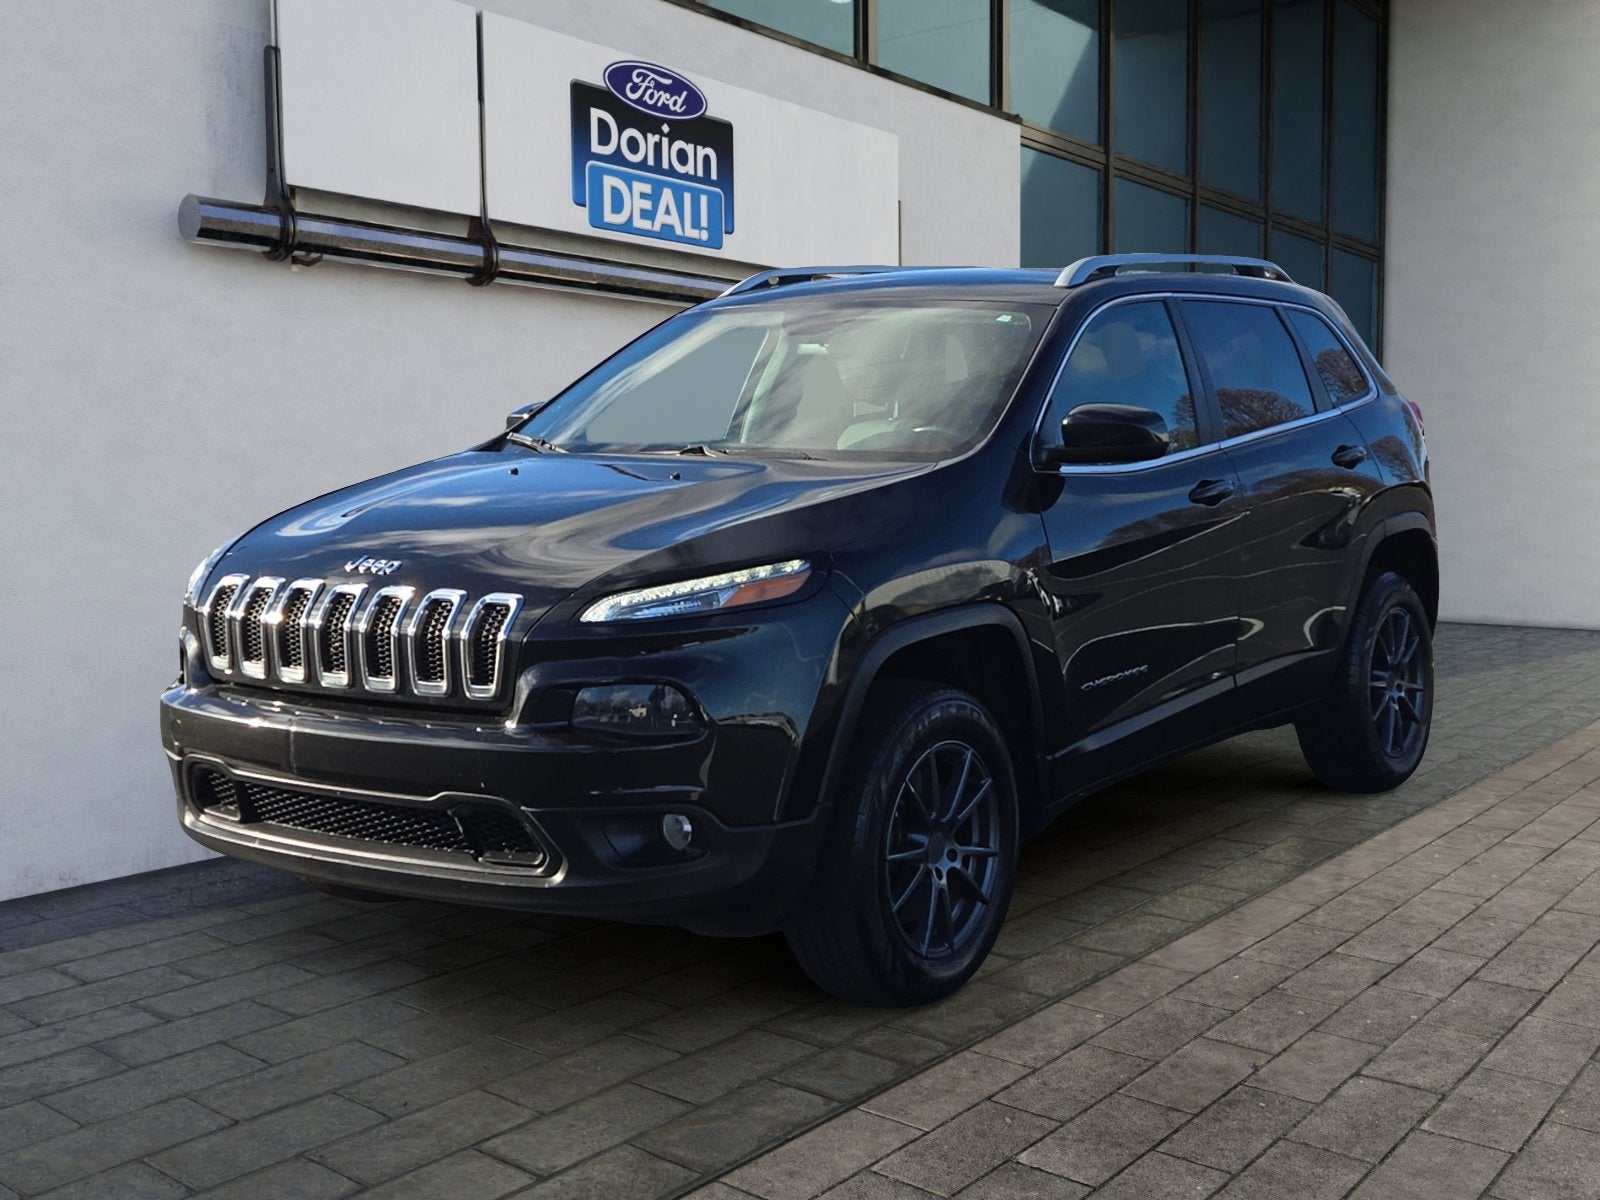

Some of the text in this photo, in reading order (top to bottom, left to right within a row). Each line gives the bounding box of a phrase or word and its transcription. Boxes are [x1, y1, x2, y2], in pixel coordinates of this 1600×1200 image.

[625, 68, 687, 113] Ford
[590, 107, 718, 181] Dorian
[602, 174, 709, 241] DEAL!
[344, 555, 402, 575] Jeep
